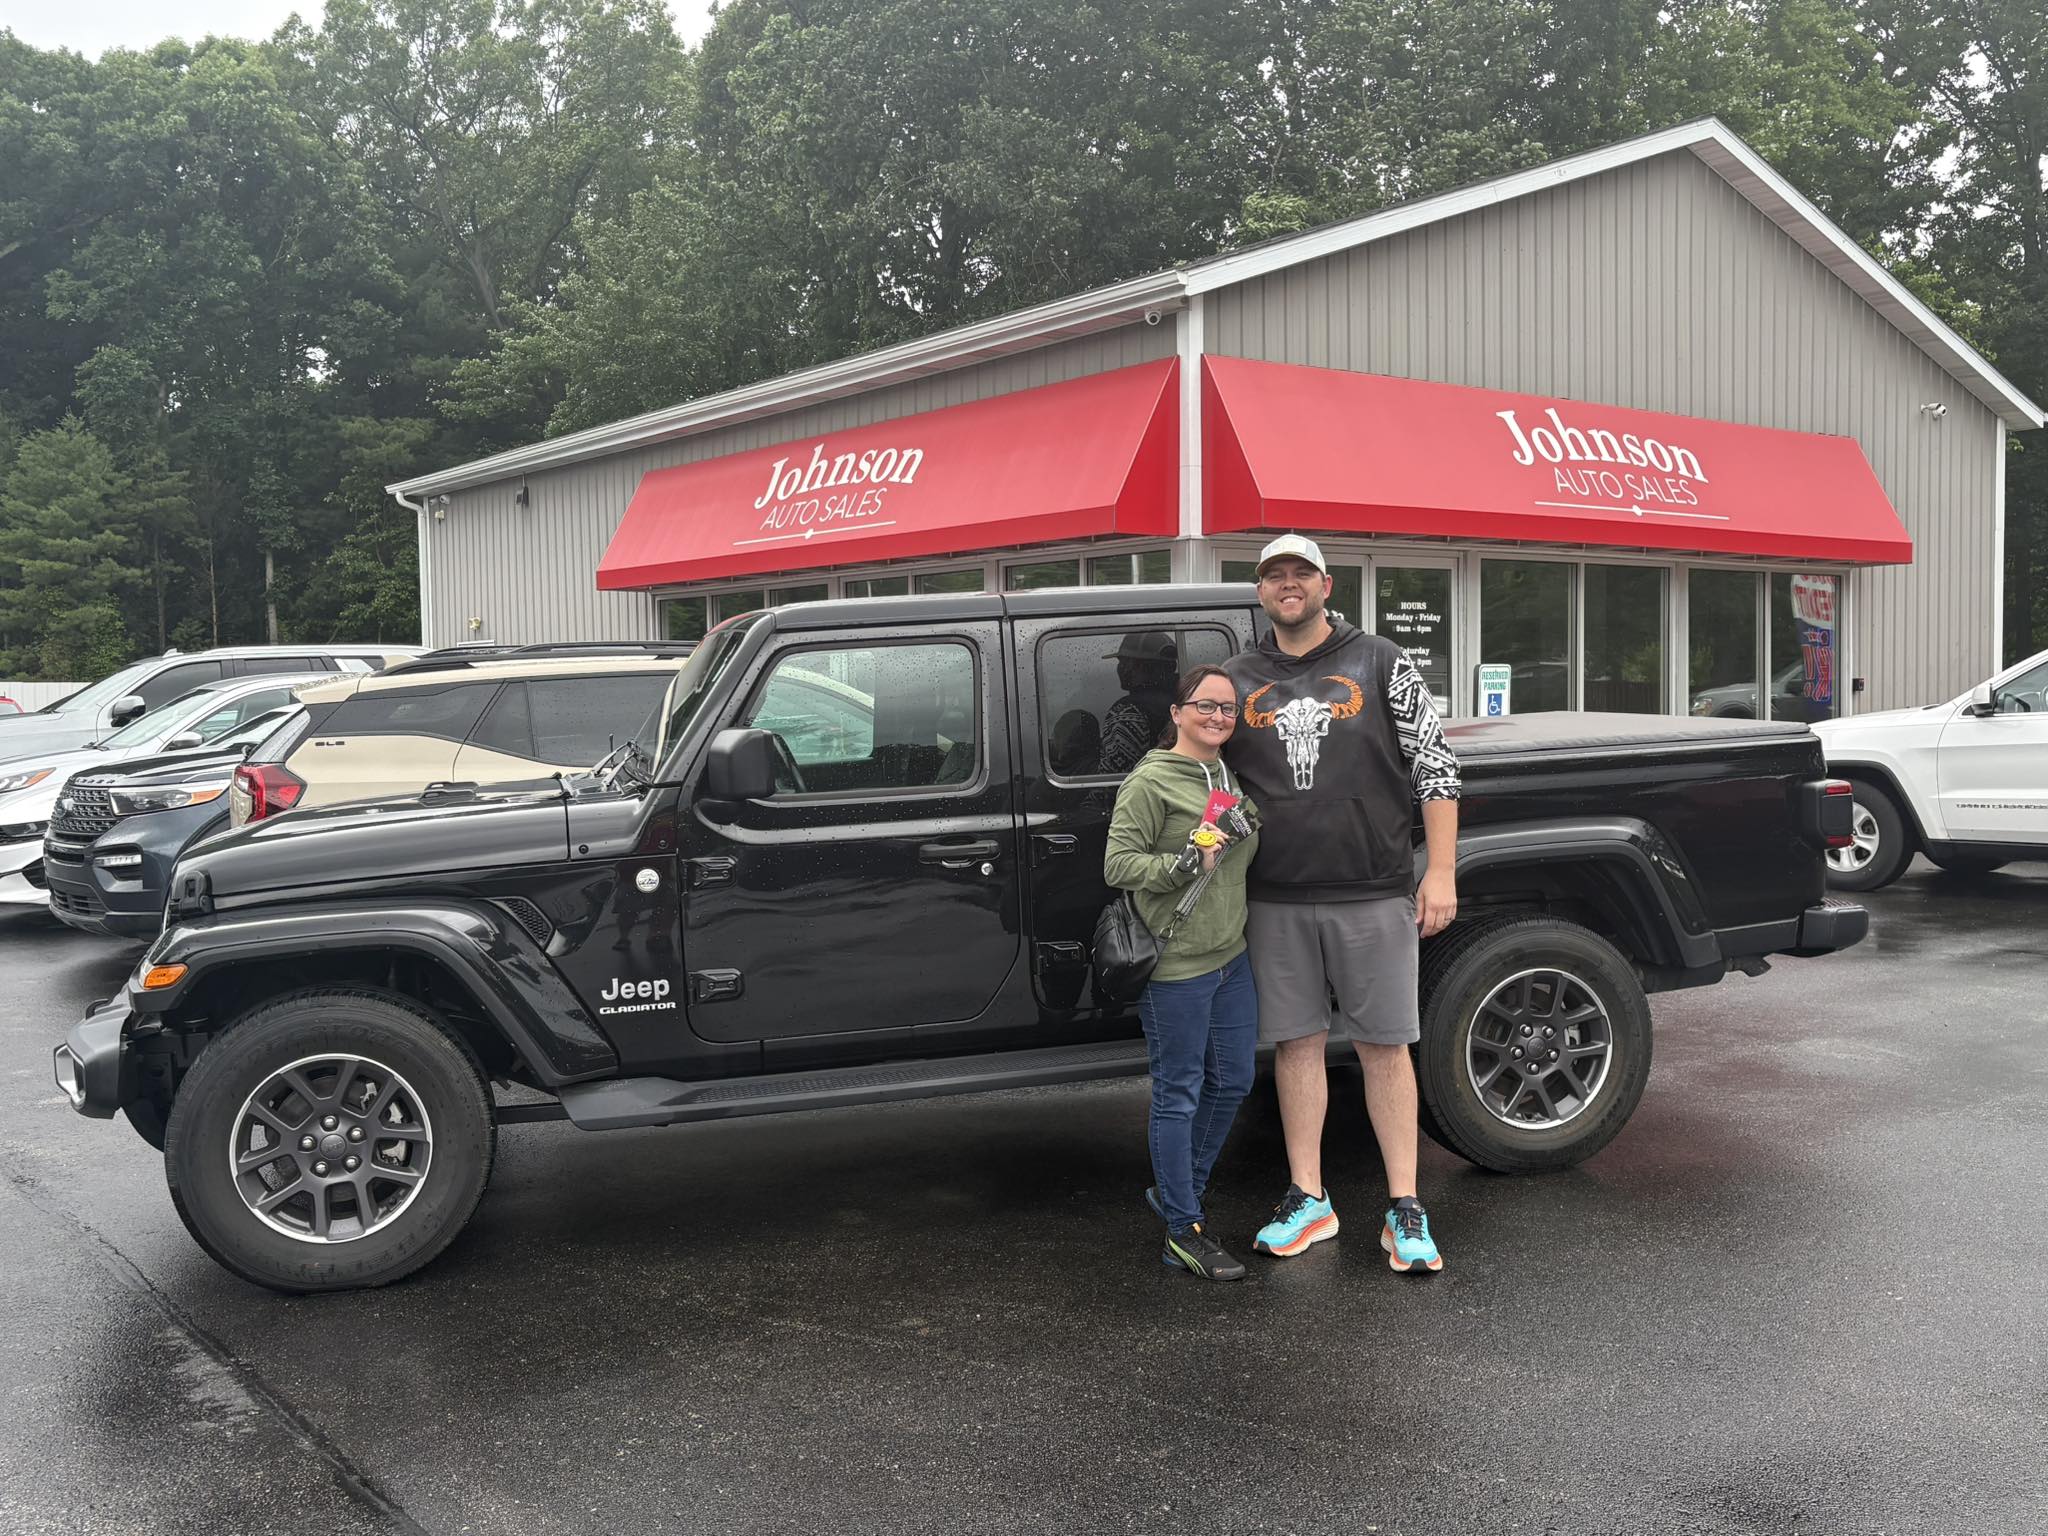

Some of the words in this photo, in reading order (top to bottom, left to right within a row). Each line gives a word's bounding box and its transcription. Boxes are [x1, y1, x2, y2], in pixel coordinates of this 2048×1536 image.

[1496, 407, 1709, 484] Johnson
[754, 443, 923, 509] Johnson
[1554, 467, 1623, 498] AUTO
[1625, 473, 1697, 505] SALES
[760, 499, 820, 530] AUTO
[819, 488, 888, 522] SALES
[1401, 602, 1427, 610] HOURS
[1386, 613, 1413, 623] Monday
[1420, 613, 1441, 623] Friday
[1481, 671, 1508, 680] RESERVED
[1484, 681, 1507, 690] PARKING
[1231, 805, 1252, 834] Johnson
[601, 978, 670, 1001] Jeep
[600, 1002, 676, 1014] GLADIATOR
